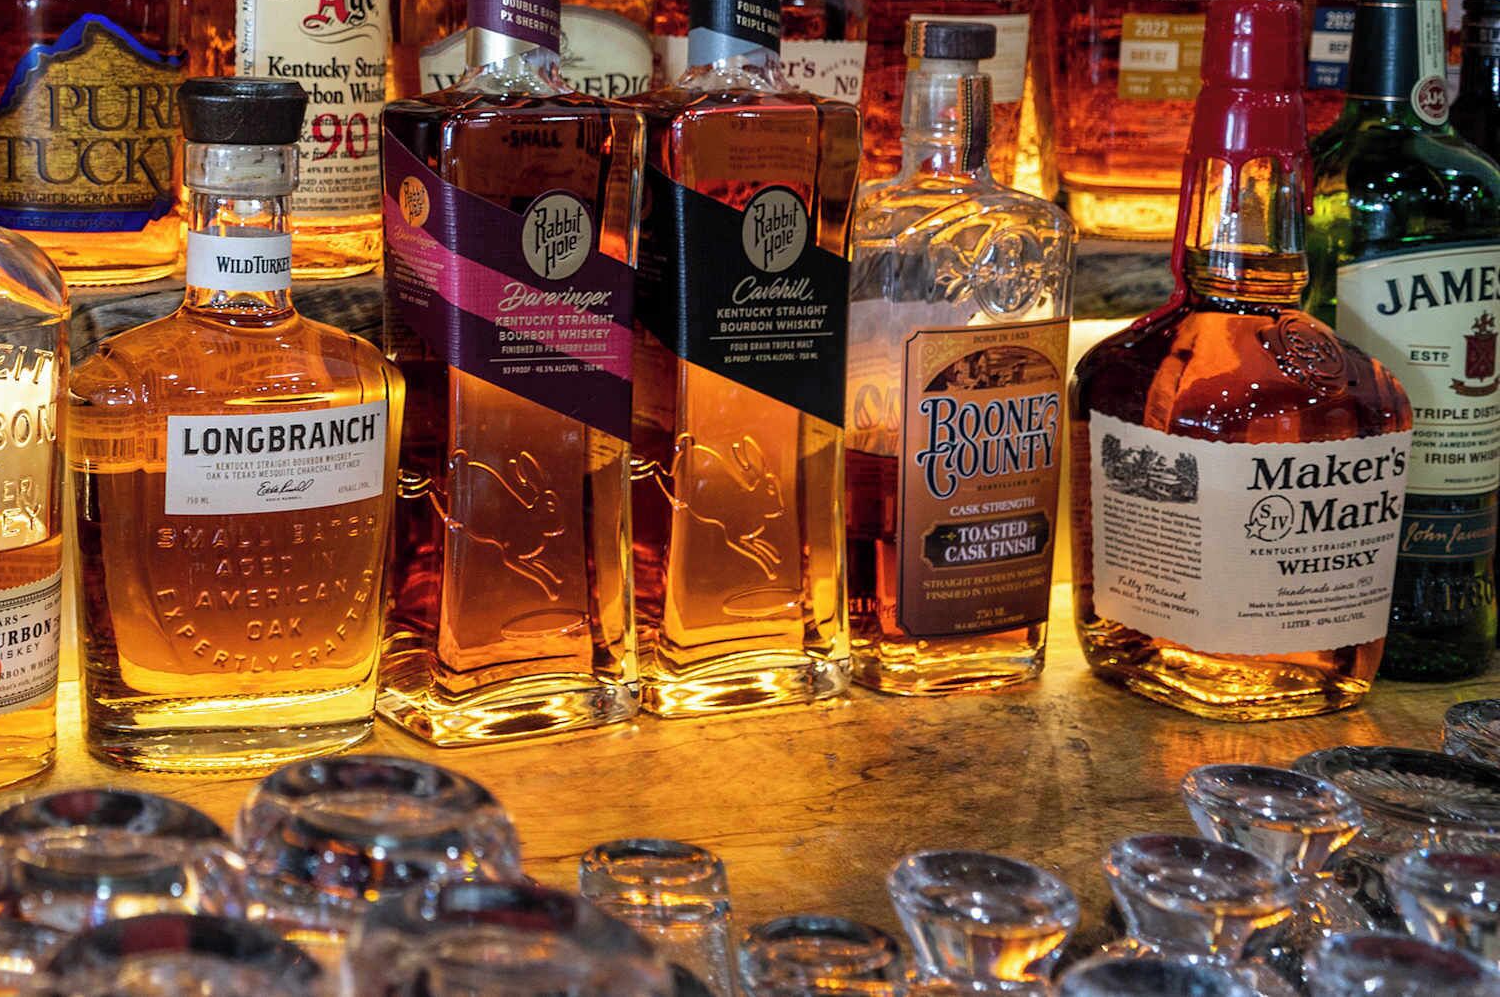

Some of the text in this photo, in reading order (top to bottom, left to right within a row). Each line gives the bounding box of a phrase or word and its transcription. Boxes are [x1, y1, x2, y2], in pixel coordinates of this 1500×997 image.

[736, 0, 762, 14] FOUR
[500, 10, 549, 34] PX SHERRY
[735, 14, 766, 31] TRIPLE
[267, 55, 351, 83] Kentucky
[311, 111, 370, 163] 90
[534, 204, 584, 254] Rabbit
[753, 202, 800, 248] Rabbit
[544, 235, 578, 277] Hole
[763, 232, 794, 271] Hole
[216, 255, 254, 274] WILD
[495, 313, 615, 328] KENTUCKY STRAIGHT
[716, 304, 828, 319] KENTUCKY STRAIGHT
[499, 328, 611, 343] BOURBON WHISKEY
[719, 319, 824, 334] BOURBON WHISKEY
[1413, 407, 1470, 420] TRIPLE
[182, 414, 376, 457] LONGBRANCH
[206, 458, 361, 481] OAK TEXAS MESQUITE CHARCOAL REFINED
[215, 452, 352, 472] KENTUCKY STRAIGHT BOURBON WHISKEY
[915, 431, 1056, 500] COUNTY
[1246, 446, 1406, 491] Maker's
[1424, 453, 1466, 465] IRISH
[949, 496, 1036, 517] CASK STRENGTH
[1294, 490, 1400, 535] Mark
[156, 525, 275, 549] SMALL
[957, 520, 1029, 544] TOASTED
[944, 535, 1038, 563] CASK FINISH
[1250, 532, 1395, 557] KENTUCKY STRAIGHT BOURBON
[216, 555, 293, 577] AGED
[1276, 548, 1380, 576] WHISKY
[922, 577, 972, 590] STRAIGHT
[1117, 575, 1188, 602] Fully Matured
[1276, 582, 1330, 597] Handmade
[246, 617, 303, 642] OAK
[1287, 618, 1310, 629] LITER
